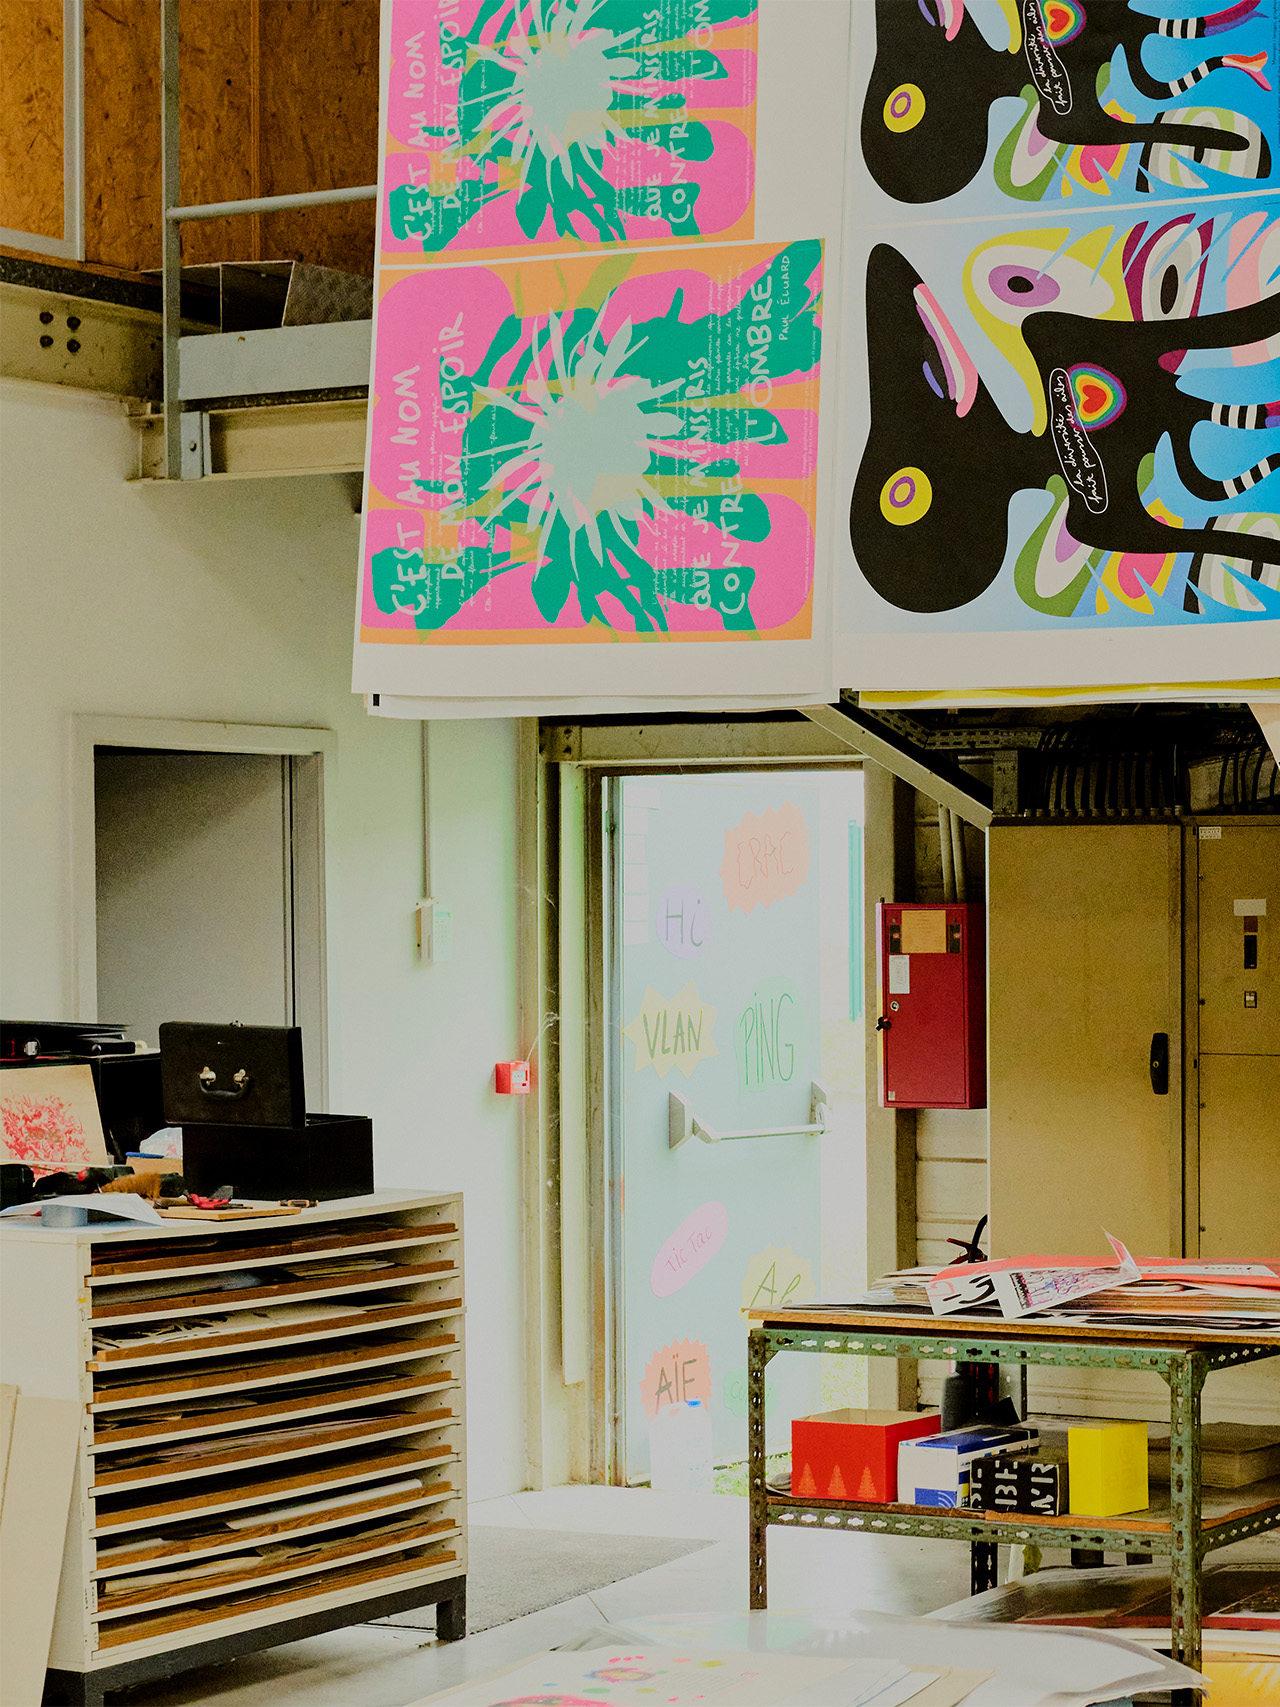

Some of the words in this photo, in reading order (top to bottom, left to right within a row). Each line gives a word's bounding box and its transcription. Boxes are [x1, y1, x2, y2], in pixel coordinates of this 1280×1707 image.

[404, 30, 426, 99] NOM
[667, 106, 691, 224] CONTRE
[780, 254, 792, 307] ÉLUARD
[778, 311, 790, 341] PAUL
[390, 365, 422, 446] NOM
[1053, 375, 1068, 403] ailes
[1065, 404, 1076, 425] des
[1054, 413, 1078, 468] diversité
[1073, 428, 1097, 469] pousser
[396, 461, 427, 505] AU
[439, 454, 464, 527] MON
[1073, 469, 1085, 487] la
[1087, 473, 1104, 504] fait
[692, 501, 710, 534] JE
[392, 521, 428, 616] C'EST
[440, 535, 464, 581] DE
[719, 473, 748, 615] CONTRE
[693, 551, 713, 612] QUE
[736, 830, 795, 890] CRAC
[642, 1009, 703, 1060] VLAN
